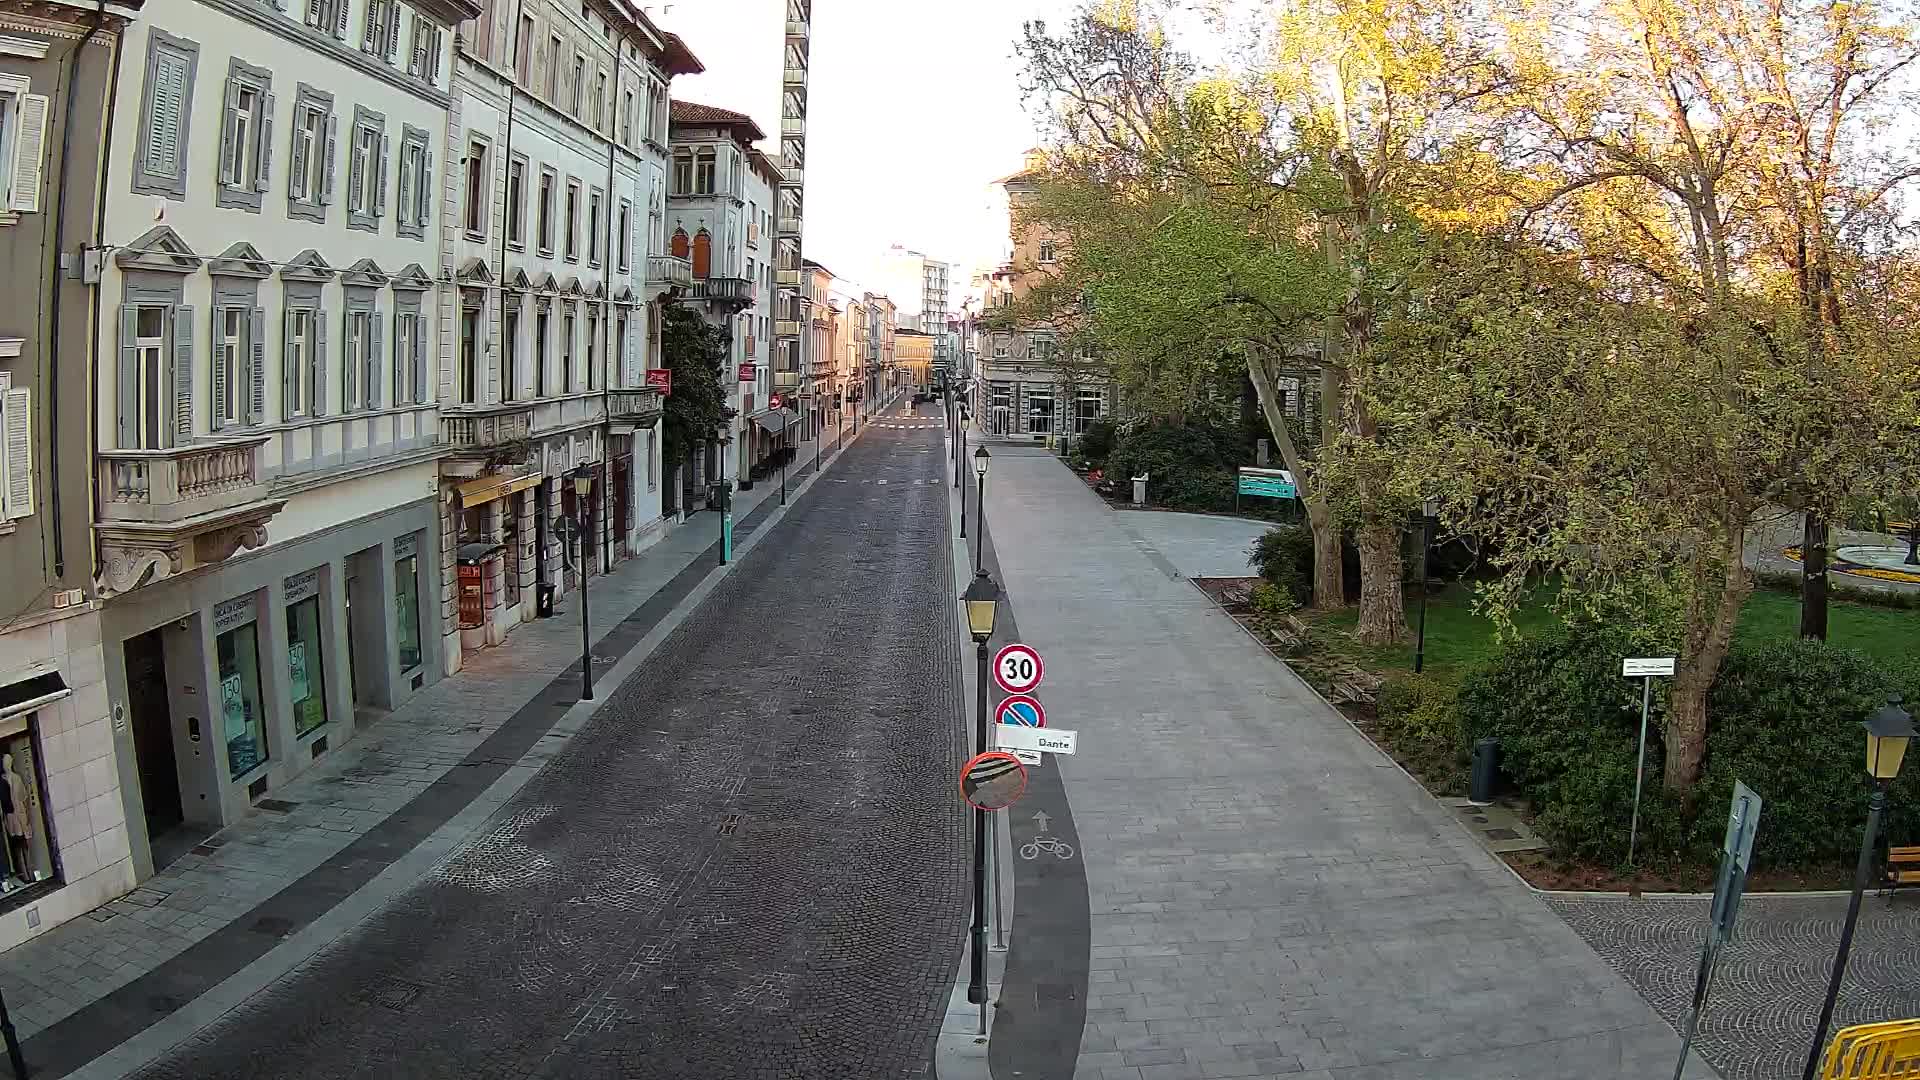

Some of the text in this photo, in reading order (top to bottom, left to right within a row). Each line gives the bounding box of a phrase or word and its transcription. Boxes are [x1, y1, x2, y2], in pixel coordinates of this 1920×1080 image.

[1005, 658, 1033, 680] 30
[223, 677, 241, 699] 130
[1038, 738, 1070, 749] Dante
